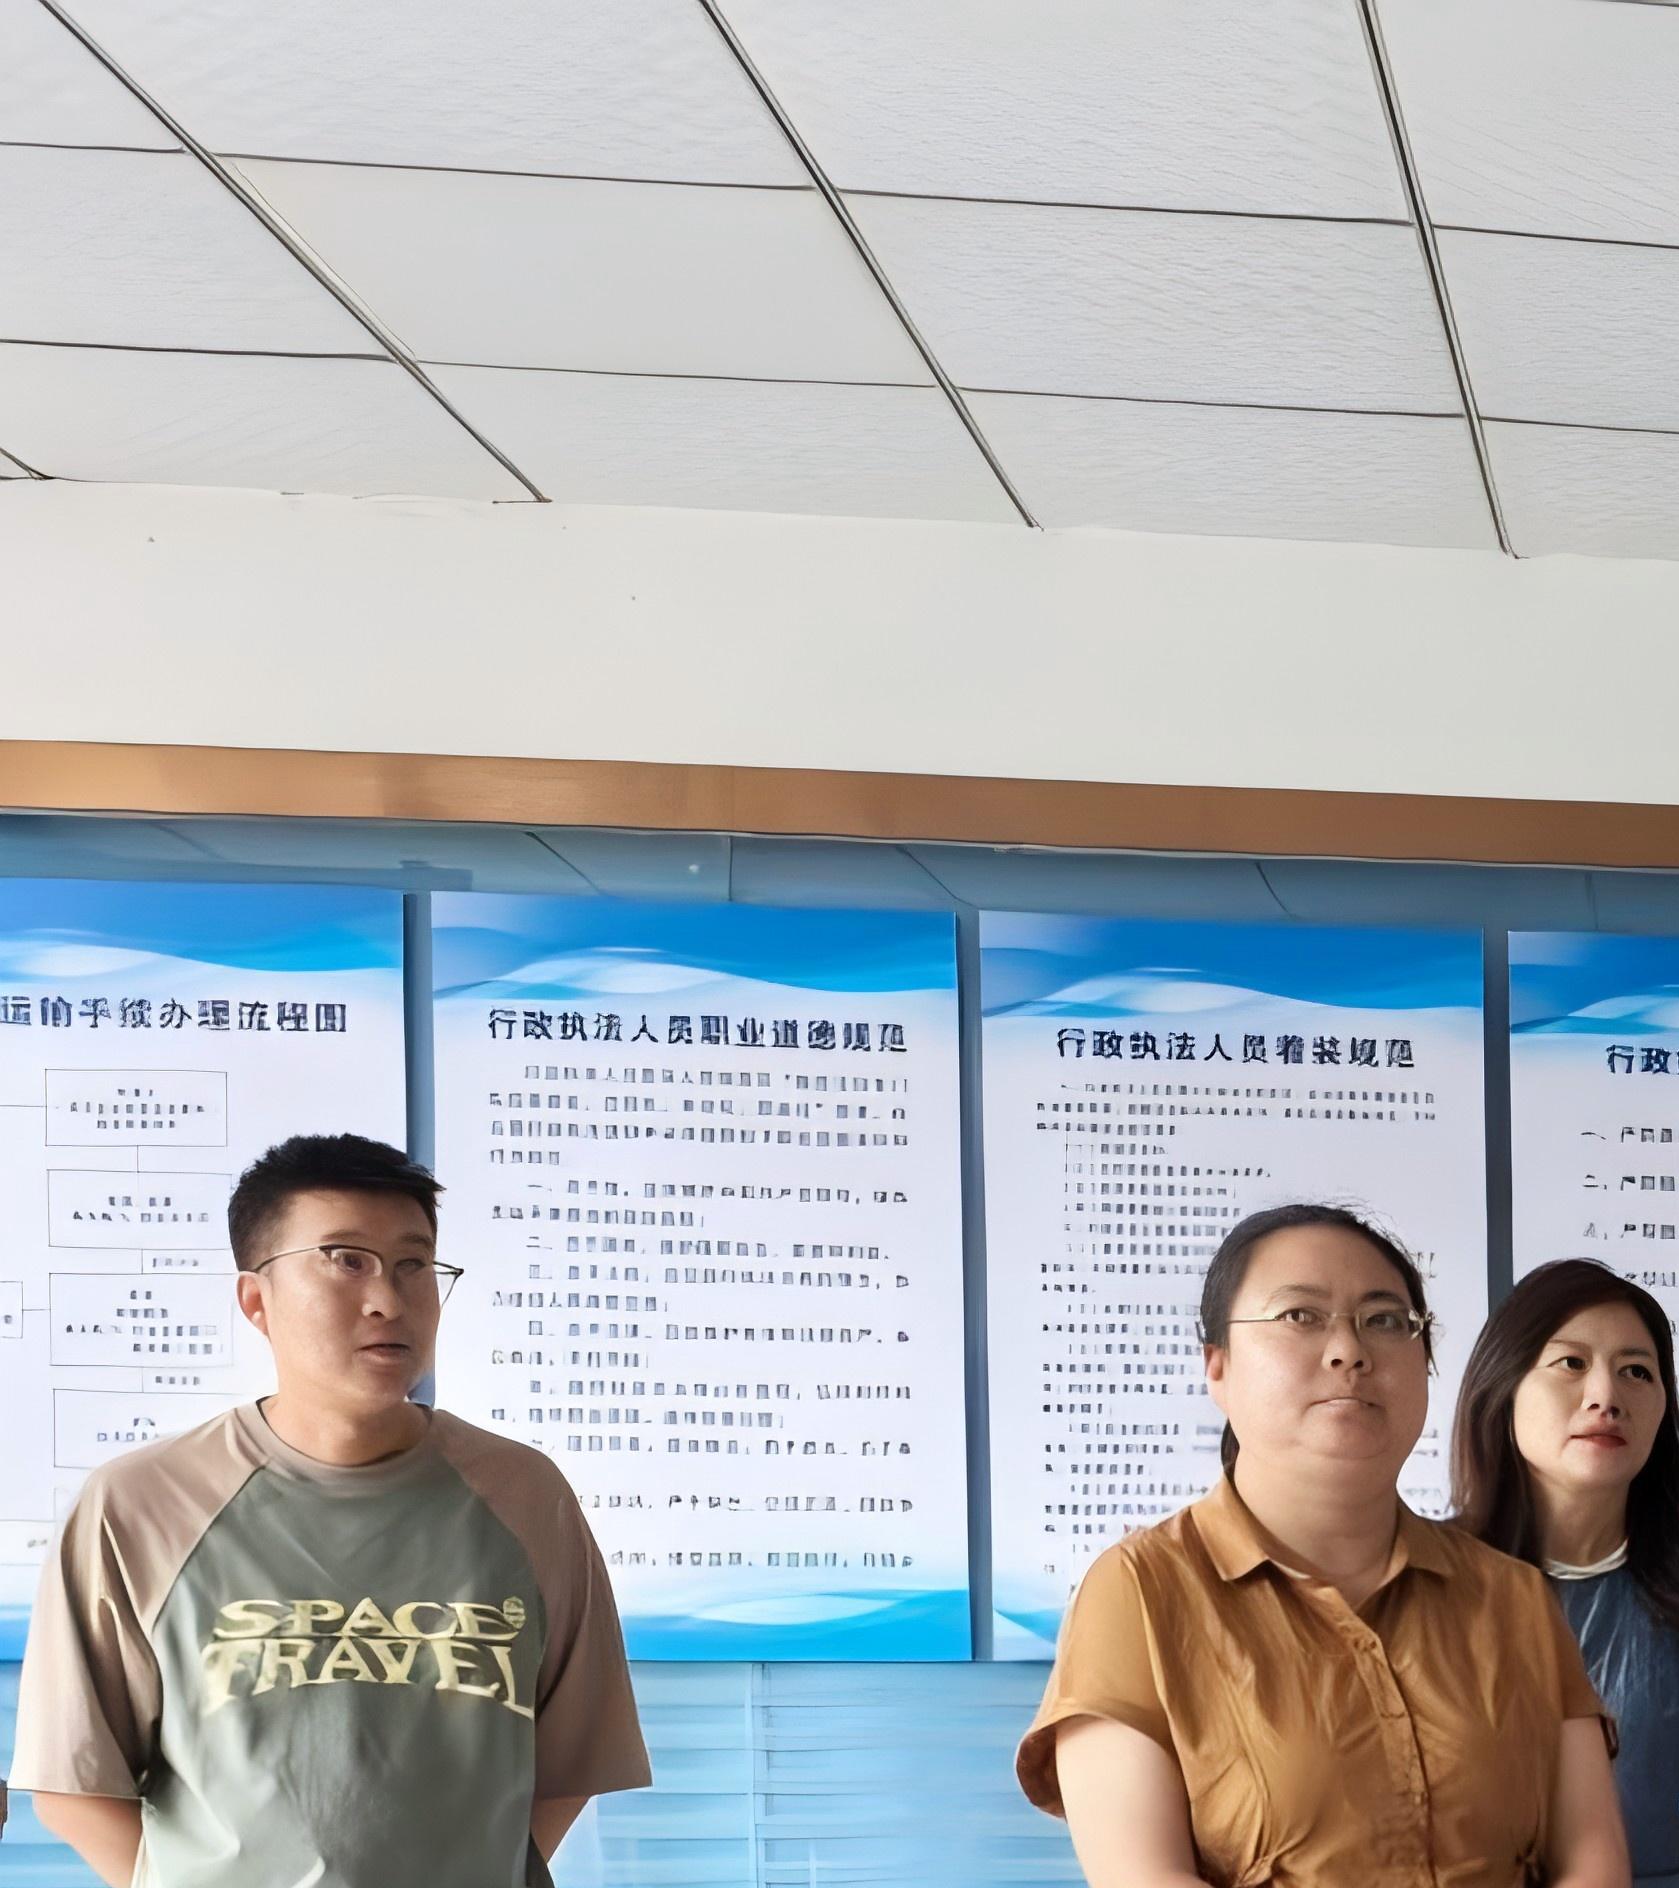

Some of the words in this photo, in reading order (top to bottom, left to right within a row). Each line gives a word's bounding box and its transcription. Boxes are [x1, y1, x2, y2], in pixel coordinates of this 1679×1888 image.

[487, 1006, 909, 1054] 行政执法人员职业道德规范
[1056, 1027, 1416, 1069] 行政执法人员着装规范
[212, 1597, 520, 1640] SPACE
[202, 1636, 535, 1720] TRAVEL
